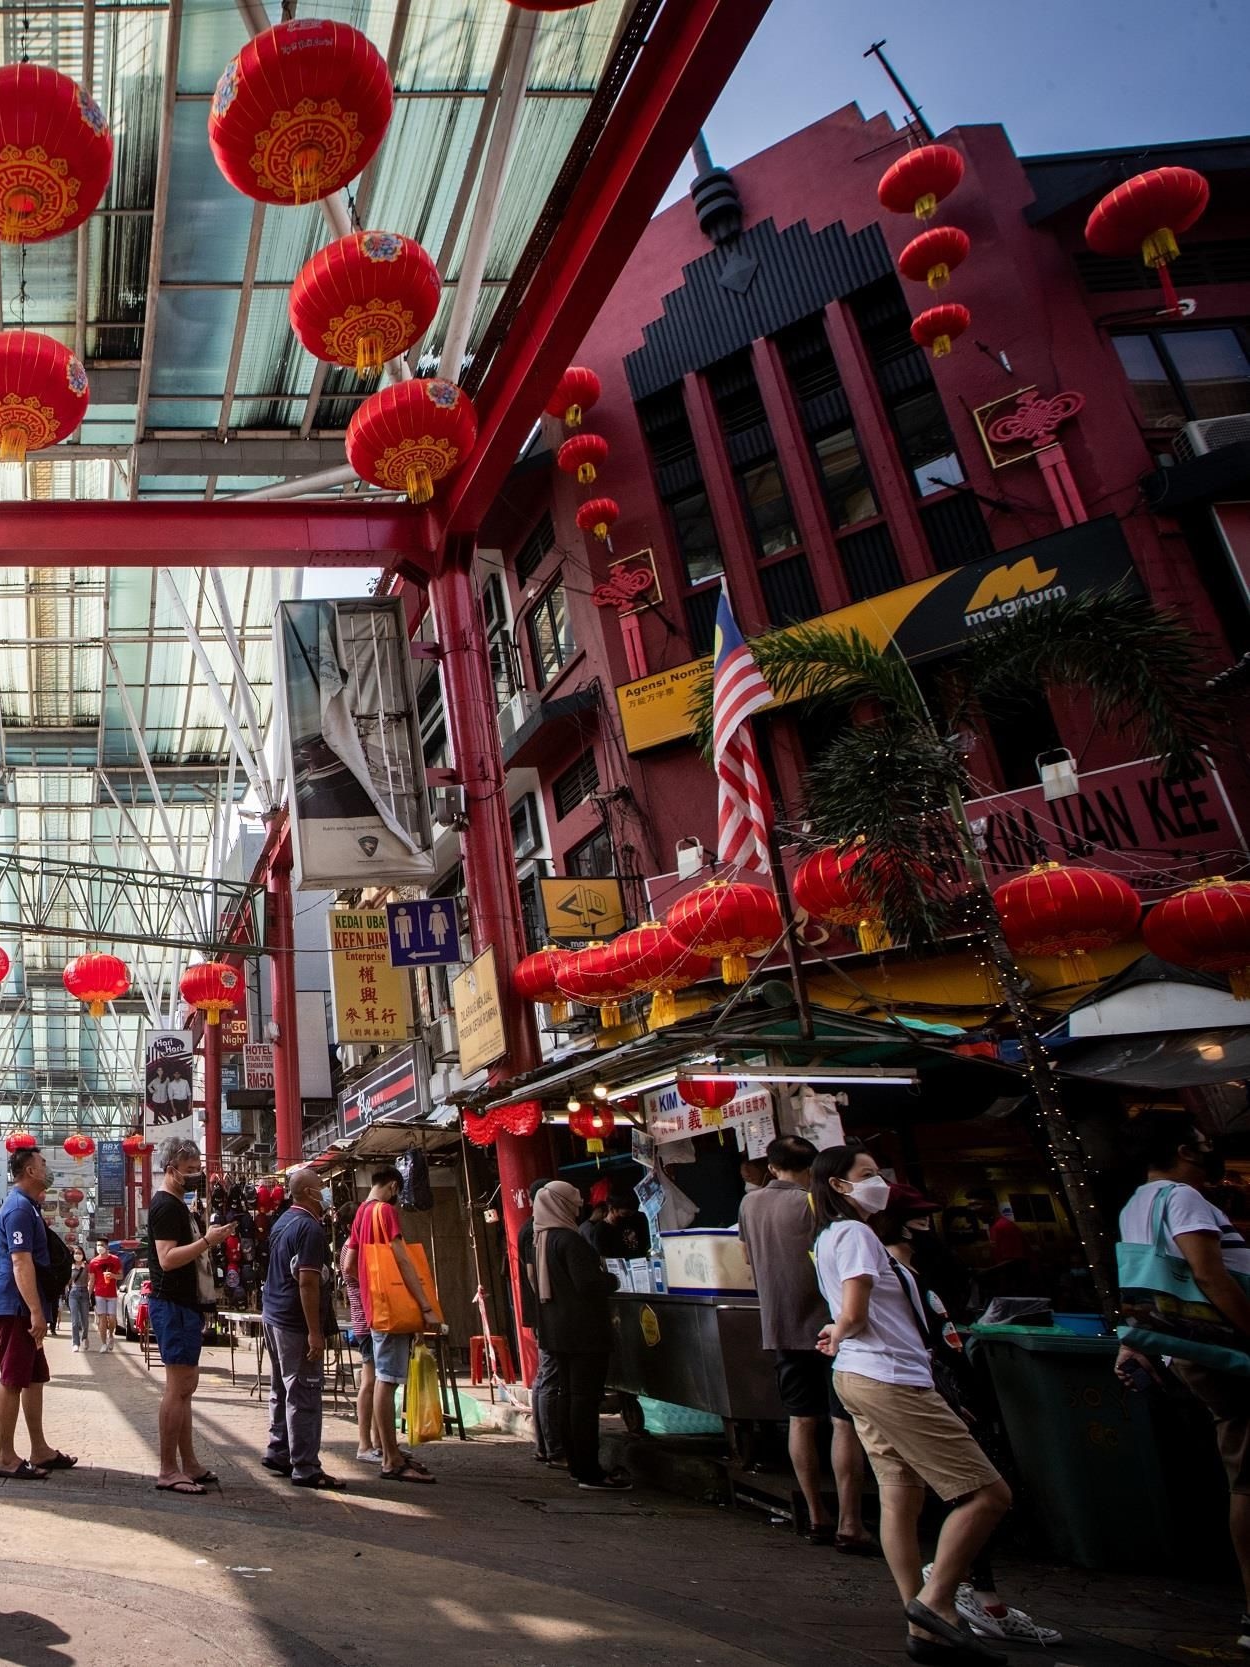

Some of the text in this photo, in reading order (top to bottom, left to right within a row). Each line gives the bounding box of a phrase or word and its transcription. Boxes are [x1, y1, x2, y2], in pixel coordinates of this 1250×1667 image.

[964, 585, 1067, 627] magnum
[625, 660, 714, 698] Agensi Nombo
[986, 806, 1048, 876] KIM
[1047, 785, 1139, 860] LIAN
[1139, 776, 1220, 841] KEE
[335, 915, 363, 929] KEDAI
[334, 931, 389, 950] KEEN HIN
[345, 951, 386, 963] Enterprise
[156, 1038, 173, 1047] Hari
[222, 1034, 246, 1046] Night
[165, 1045, 182, 1053] Hari
[245, 1045, 272, 1055] HOTEL
[247, 1072, 274, 1089] RM50
[658, 1092, 678, 1113] KIM
[13, 1231, 24, 1245] 3
